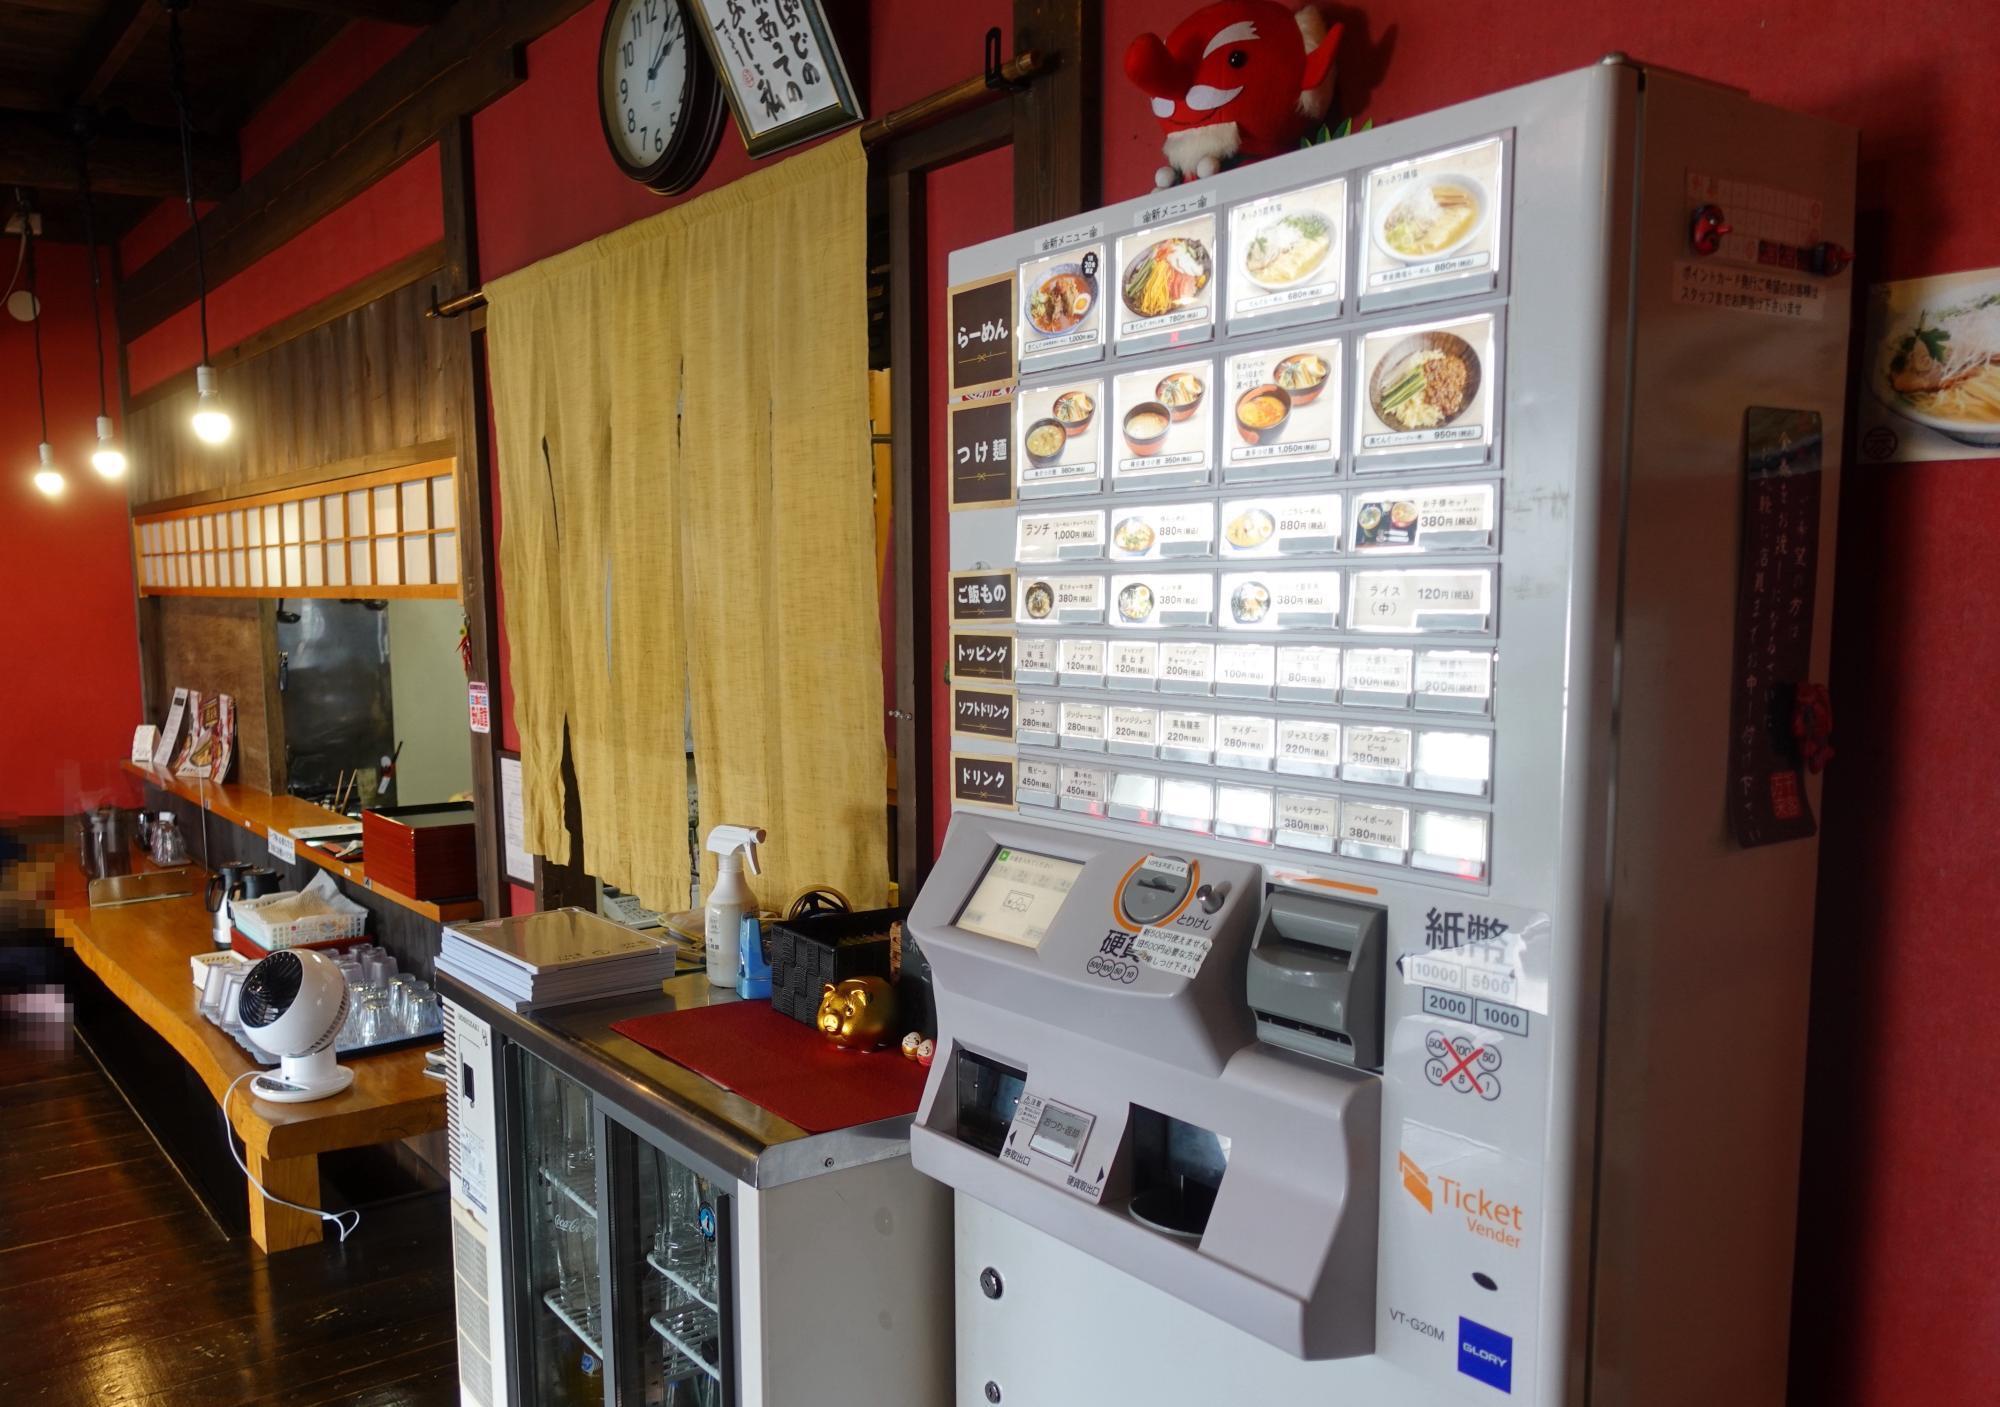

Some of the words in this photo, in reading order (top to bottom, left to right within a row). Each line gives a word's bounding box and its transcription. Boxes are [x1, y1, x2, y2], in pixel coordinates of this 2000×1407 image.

[632, 12, 642, 40] 11
[622, 40, 635, 70] 10
[619, 78, 629, 105] 9
[627, 108, 637, 134] 8
[640, 126, 648, 152] 7
[654, 128, 663, 153] 6
[957, 318, 1008, 349] らーめん
[957, 439, 1008, 464] つけ麺
[1025, 523, 1050, 537] ランチ
[1279, 520, 1327, 531] 880円(税込)
[1420, 515, 1477, 528] 380円(税込)
[1054, 529, 1096, 541] 1,000円(税込)
[957, 584, 1007, 605] ご飯もの
[1057, 593, 1092, 604] 380円(税込)
[1158, 595, 1198, 606] 380円(税込)
[1276, 594, 1324, 606] 380円(税込)
[1367, 585, 1401, 598] ライス
[1416, 587, 1474, 601] 120円(税込)
[1369, 602, 1398, 617] (中)
[957, 643, 1008, 664] トッピング
[958, 700, 1010, 720] ソフトドリンク
[1167, 732, 1205, 744] 220円(税込)
[1231, 725, 1258, 735] サイダー
[1287, 729, 1330, 743] ジャスミン茶
[1224, 737, 1265, 751] 280円(税込)
[1285, 743, 1330, 758] 220円(税込)
[1352, 752, 1401, 767] 380円(税込)
[962, 767, 1006, 789] ドリンク
[1284, 804, 1330, 816] レモンサワー
[1284, 818, 1330, 833] 380円(税込)
[1354, 814, 1393, 827] ハイボール
[1349, 827, 1397, 843] 380円(税込)
[1176, 913, 1213, 931] とりけし
[1089, 960, 1101, 970] 500
[1102, 963, 1113, 973] 100
[1115, 966, 1123, 975] 50
[1127, 969, 1135, 978] 10
[1415, 963, 1460, 985] 10000
[1430, 995, 1467, 1017] 2000
[1483, 1008, 1520, 1029] 1000
[1482, 1051, 1496, 1064] 50
[1431, 1066, 1443, 1079] 10
[1043, 1117, 1081, 1138] おつり・返却
[1003, 1147, 1031, 1167] 券取出口
[1066, 1175, 1101, 1198] 硬貨取出口
[1438, 1175, 1524, 1231] Ticket
[1466, 1216, 1521, 1249] Vender
[1389, 1307, 1446, 1342] VT-G20M
[1461, 1341, 1508, 1369] GLORY
